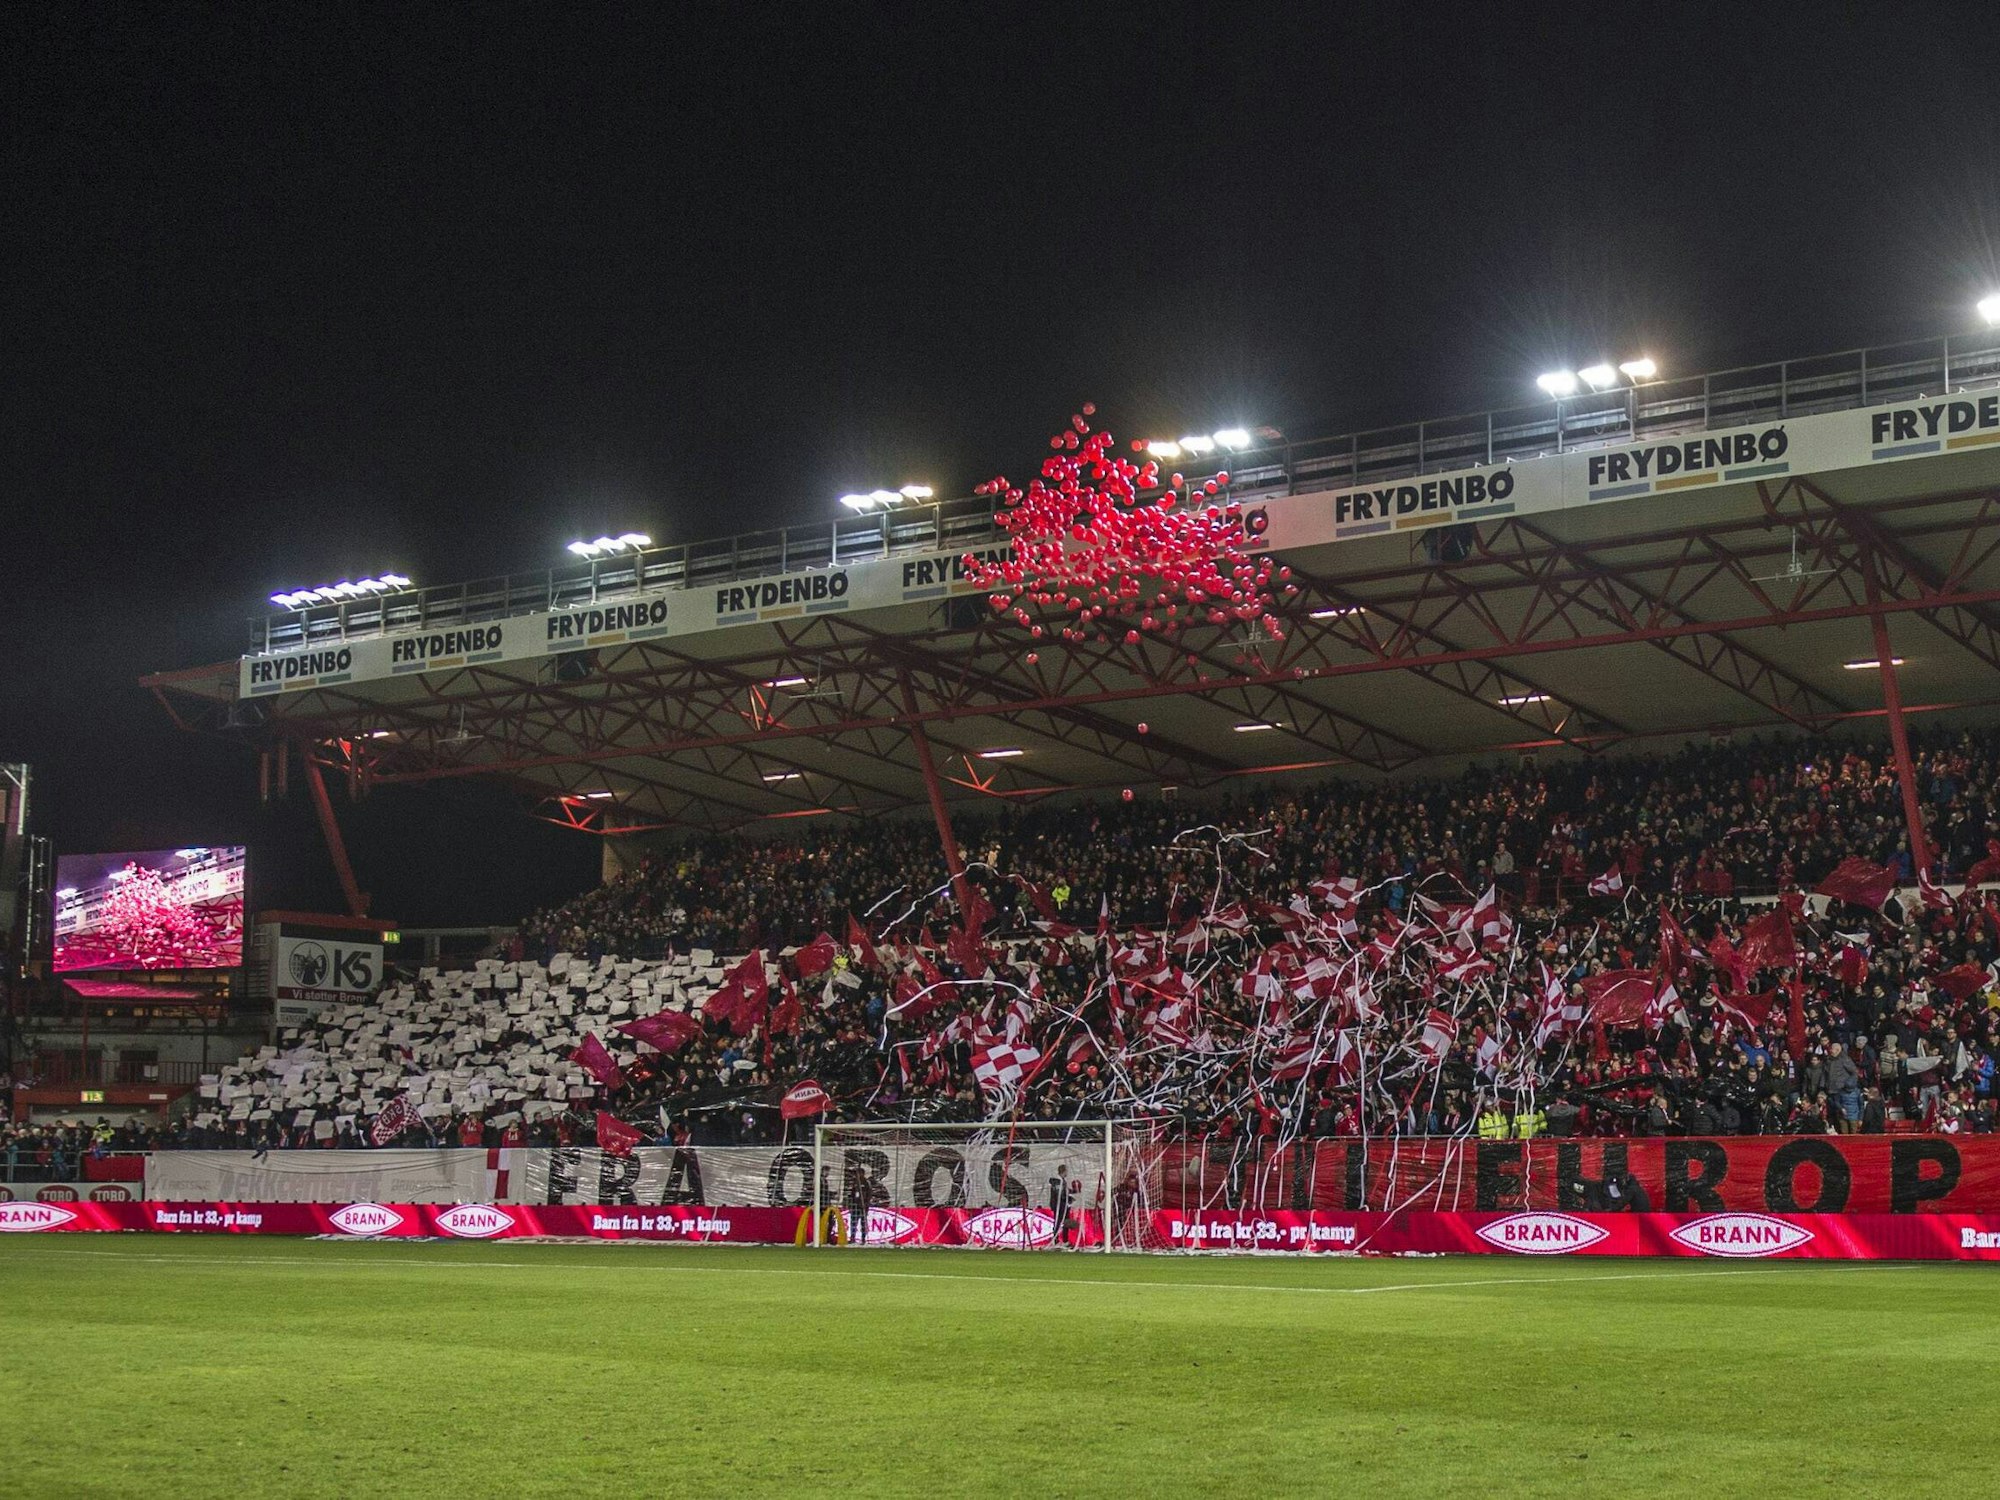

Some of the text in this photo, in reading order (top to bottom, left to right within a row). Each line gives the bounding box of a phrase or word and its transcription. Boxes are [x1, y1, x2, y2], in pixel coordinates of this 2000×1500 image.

[1872, 396, 2000, 444] FRYDE
[1589, 425, 1789, 486] FRYDENBØ
[1336, 467, 1515, 524] FRYDENBØ
[717, 569, 849, 613] FRYDENBØ
[547, 597, 668, 639] FRYDENBØ
[392, 623, 503, 663] FRYDENBØ
[250, 647, 352, 684] FRYDENBØ
[333, 948, 373, 989] K5
[292, 988, 303, 1000] Vi
[548, 1148, 706, 1206] FRA
[42, 1190, 73, 1202] TORO
[95, 1190, 126, 1202] TORO
[179, 1210, 192, 1224] fra
[193, 1210, 204, 1224] kr
[224, 1214, 235, 1228] pr
[236, 1211, 262, 1228] kamp
[345, 1213, 387, 1226] BRANN
[452, 1214, 498, 1228] BRANN
[593, 1215, 620, 1230] Barn
[622, 1215, 639, 1230] fra
[641, 1215, 654, 1230] kr
[681, 1219, 695, 1234] pr
[697, 1216, 731, 1235] kamp
[1210, 1221, 1232, 1239] fra
[1312, 1223, 1356, 1244] kamp
[1505, 1225, 1580, 1241] BRANN
[1700, 1226, 1782, 1244] BRANN
[1961, 1227, 2000, 1248] Bar
